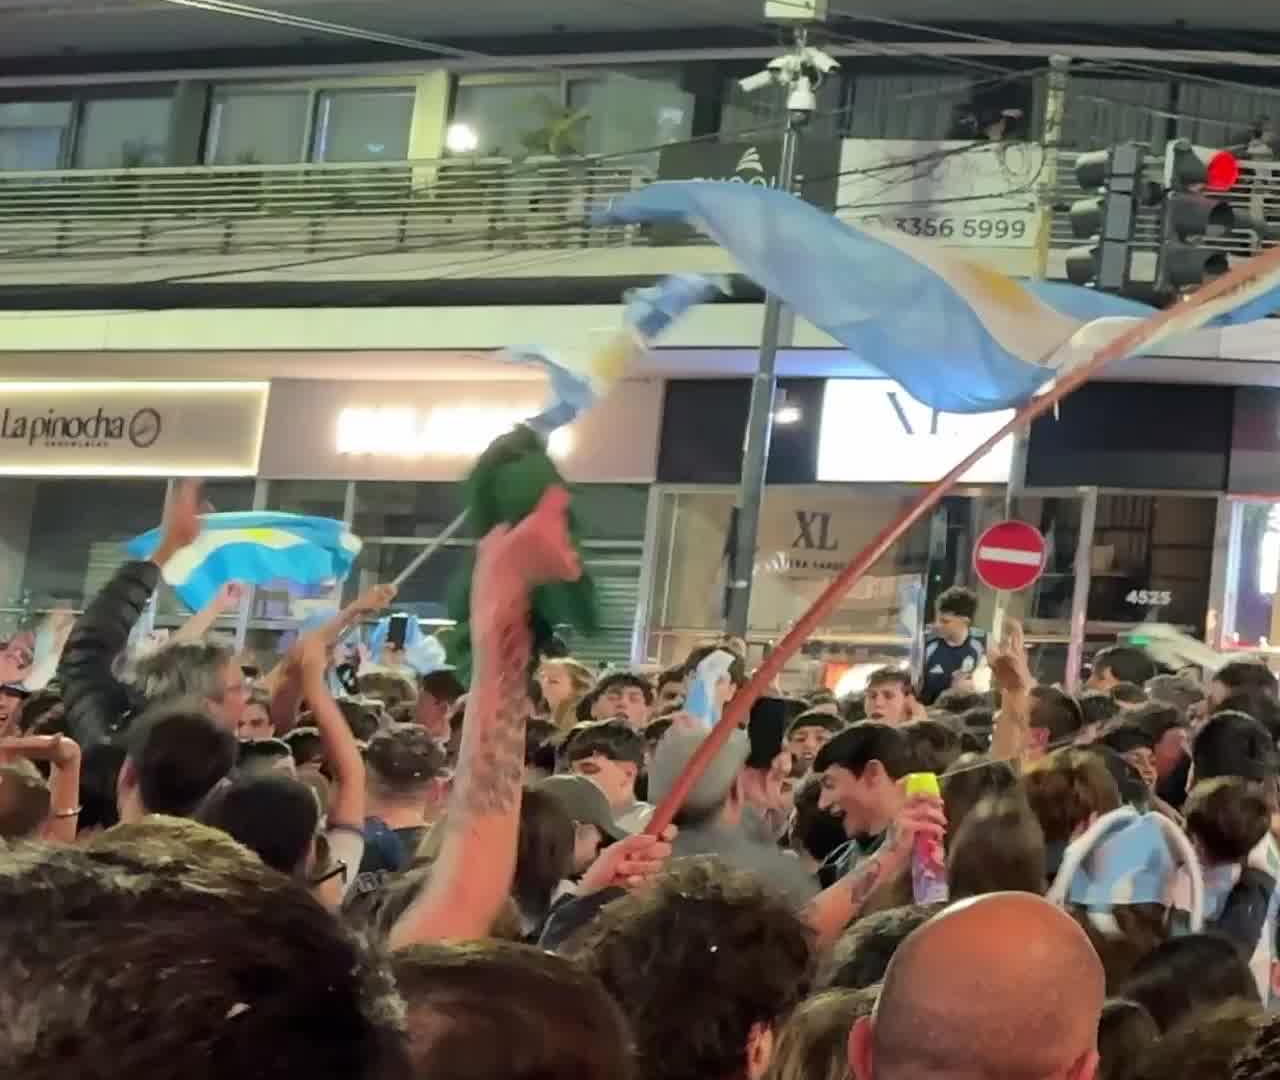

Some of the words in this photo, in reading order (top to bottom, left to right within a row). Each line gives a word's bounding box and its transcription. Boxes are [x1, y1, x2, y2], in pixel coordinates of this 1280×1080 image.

[962, 218, 1027, 240] 5999
[1, 407, 25, 439] La
[29, 407, 125, 446] pinocha
[791, 510, 839, 551] XL
